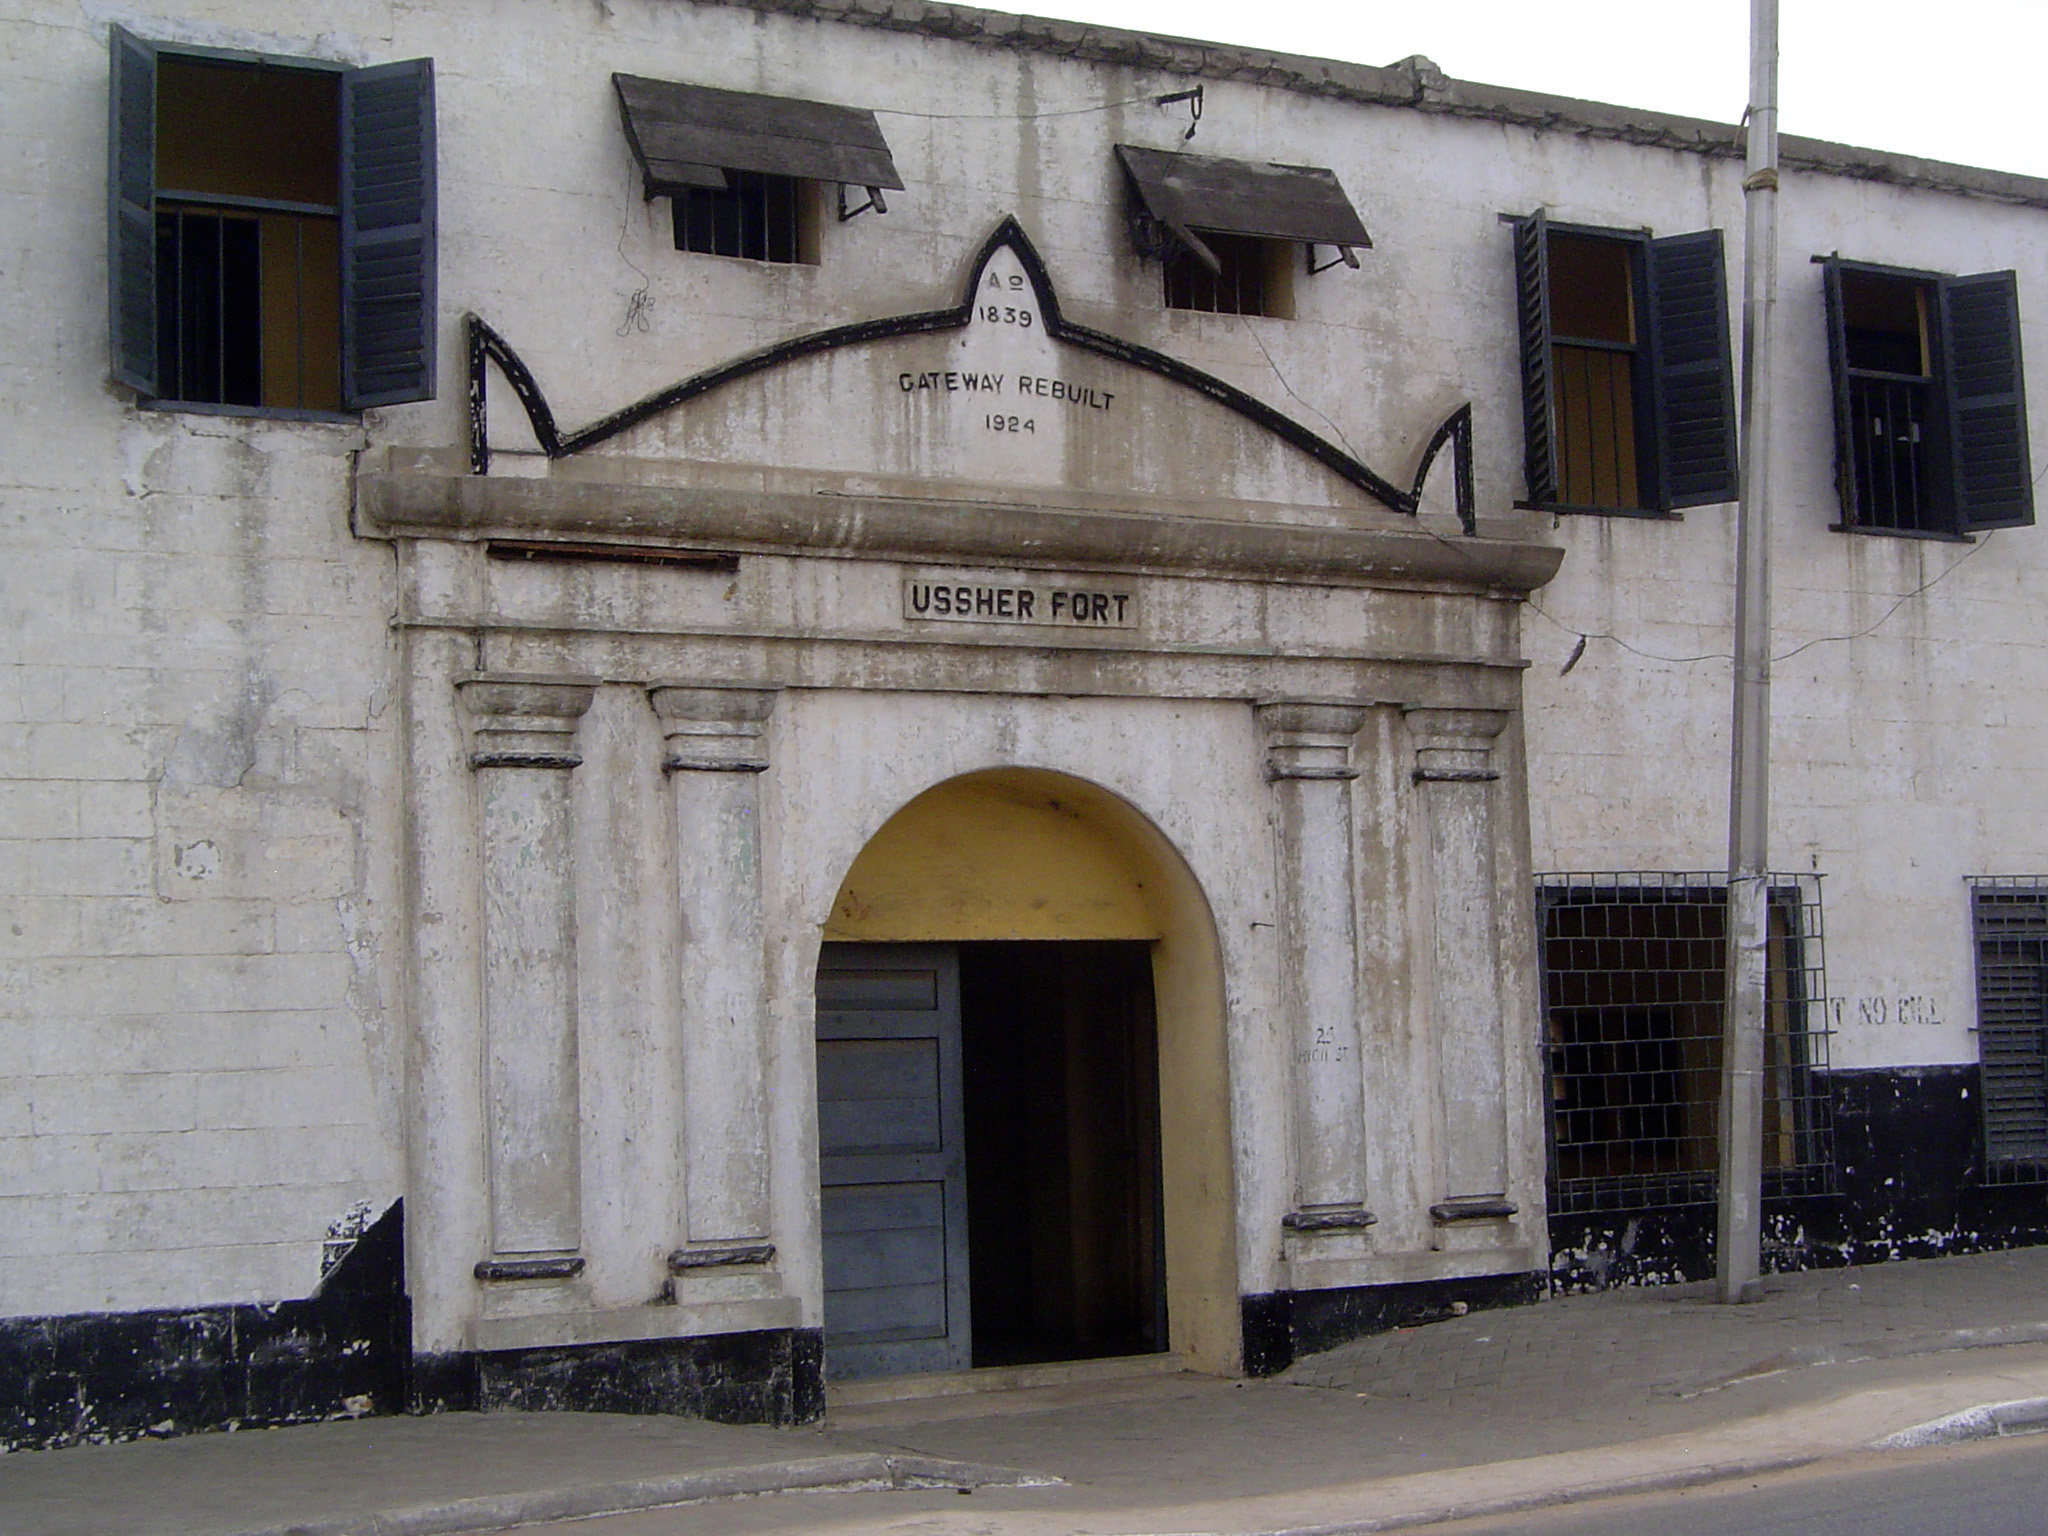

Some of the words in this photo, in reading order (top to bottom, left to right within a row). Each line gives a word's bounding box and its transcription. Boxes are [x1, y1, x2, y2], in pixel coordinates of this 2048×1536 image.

[979, 305, 1033, 328] 1839
[899, 372, 1004, 393] GATEWAY
[1018, 375, 1116, 411] REBUILT
[985, 414, 1036, 434] 1924
[911, 584, 1036, 619] USSHER
[1051, 591, 1130, 623] FORT
[1857, 996, 1888, 1025] NO
